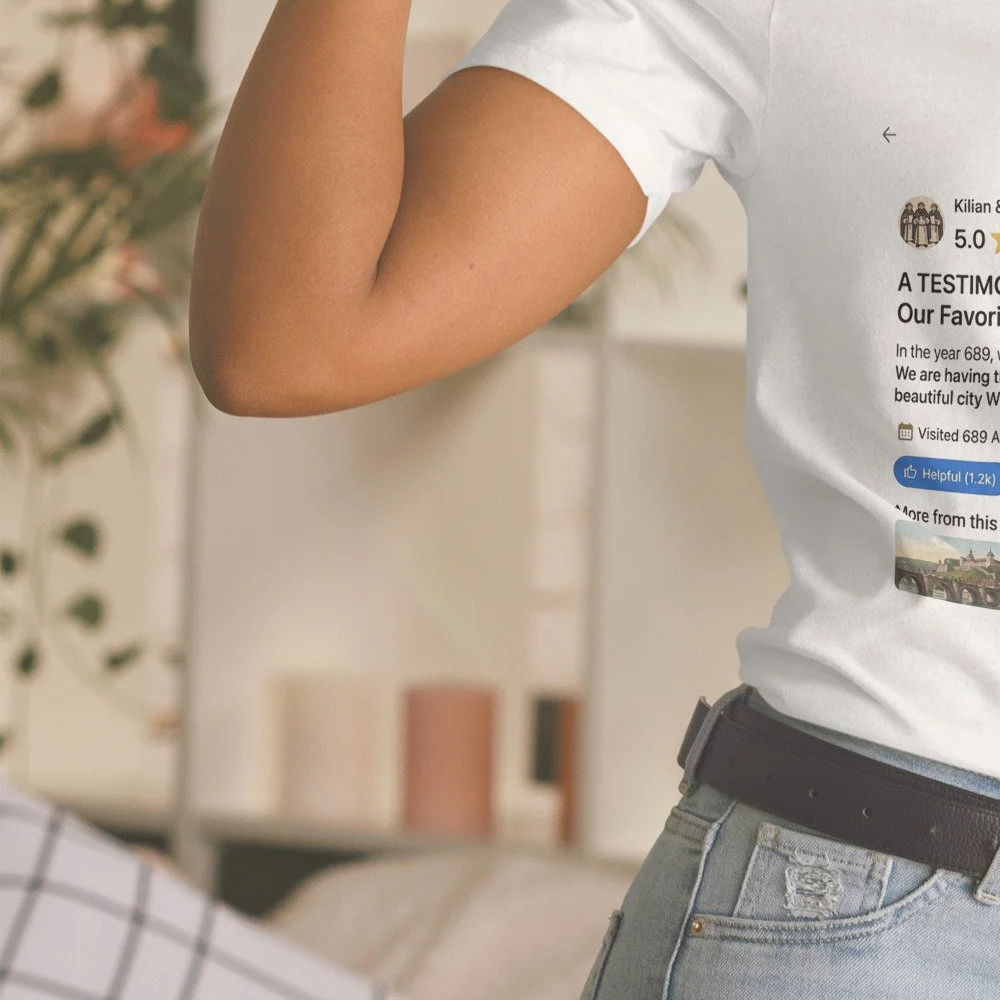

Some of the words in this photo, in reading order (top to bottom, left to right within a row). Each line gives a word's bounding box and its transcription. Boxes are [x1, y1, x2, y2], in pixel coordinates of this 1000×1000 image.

[954, 198, 992, 214] Kilian
[954, 228, 986, 250] 5.0
[897, 271, 913, 292] A
[897, 302, 935, 325] Our
[896, 343, 908, 358] In
[910, 343, 931, 360] the
[933, 348, 962, 363] year
[964, 345, 994, 364] 689,
[895, 365, 917, 381] We
[919, 370, 942, 383] are
[944, 367, 990, 388] having
[894, 387, 954, 405] beautiful
[956, 390, 983, 410] city
[918, 426, 959, 443] Visited
[962, 429, 988, 444] 689
[922, 468, 962, 483] Helpful
[964, 471, 996, 488] (1.2k)
[932, 508, 966, 528] from
[969, 513, 998, 531] this
